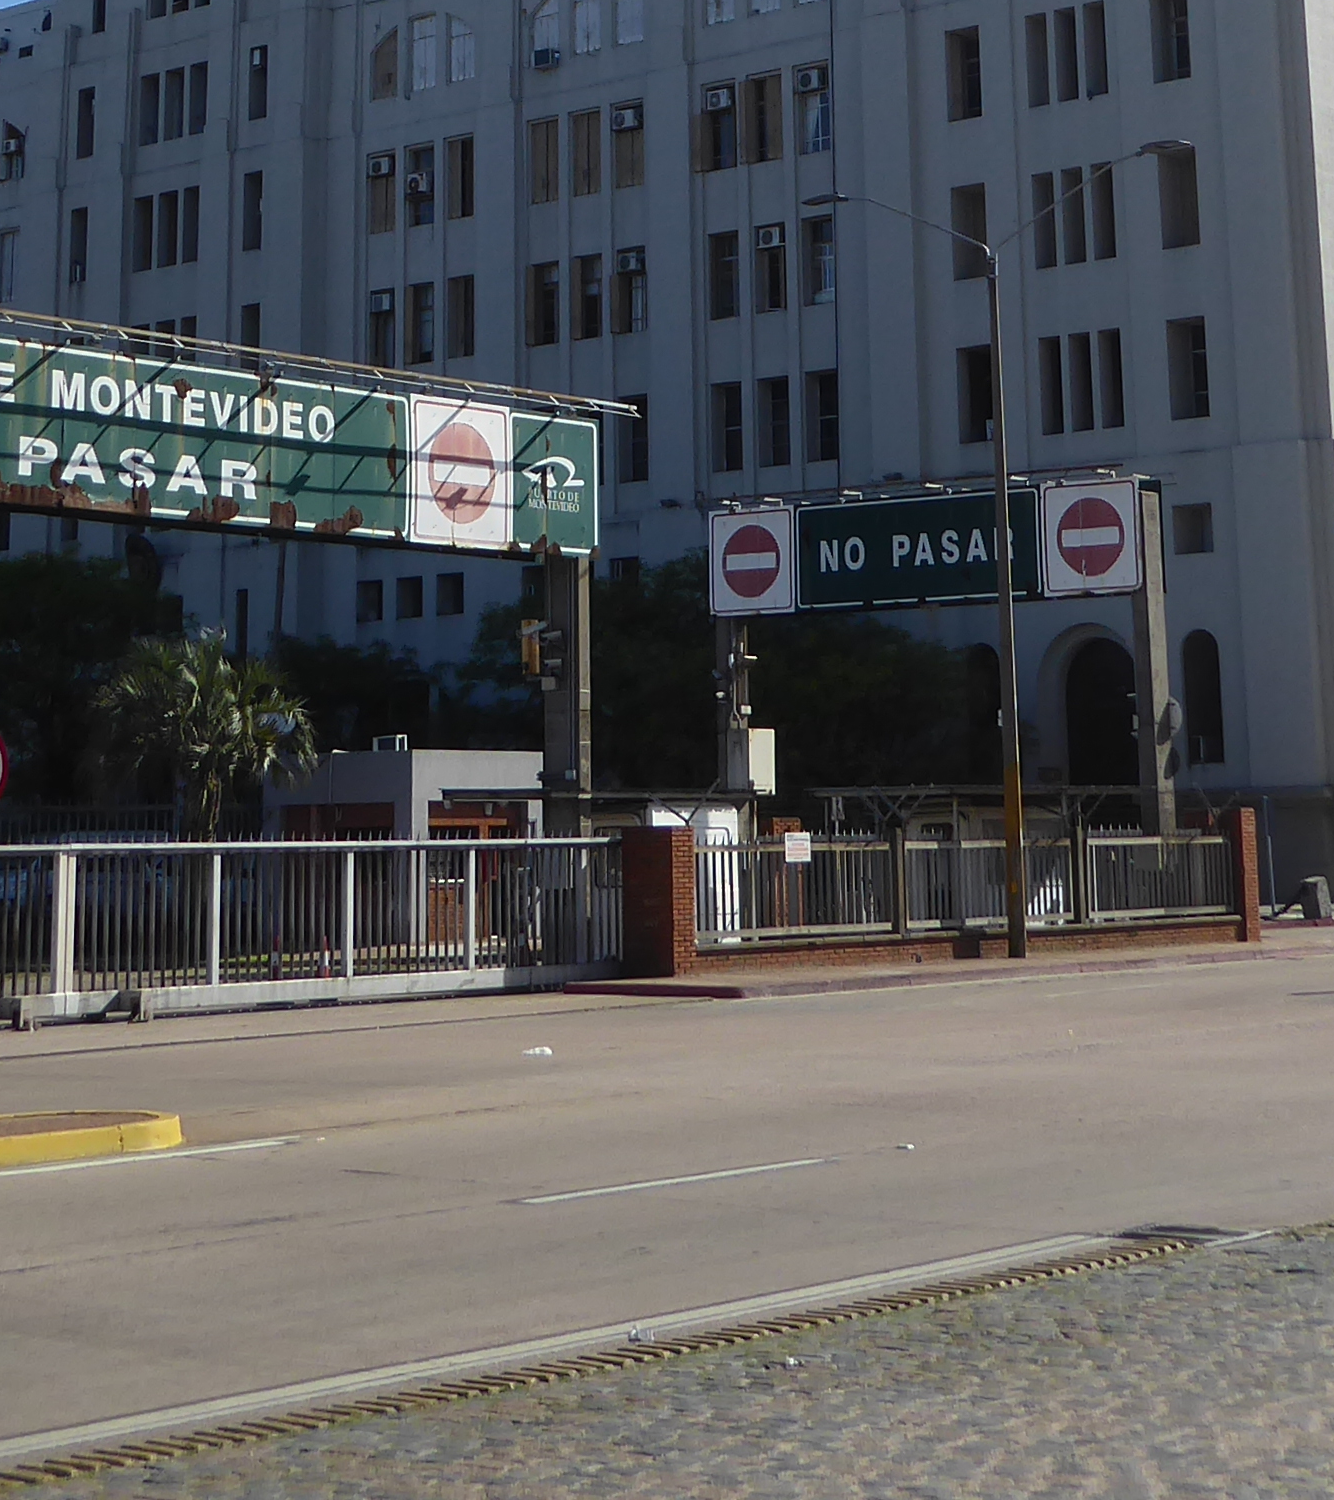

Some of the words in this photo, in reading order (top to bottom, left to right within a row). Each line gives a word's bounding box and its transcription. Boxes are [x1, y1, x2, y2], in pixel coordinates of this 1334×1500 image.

[50, 369, 336, 443] MONTEVIDEO
[17, 436, 258, 500] PASAR
[819, 536, 866, 572] NO
